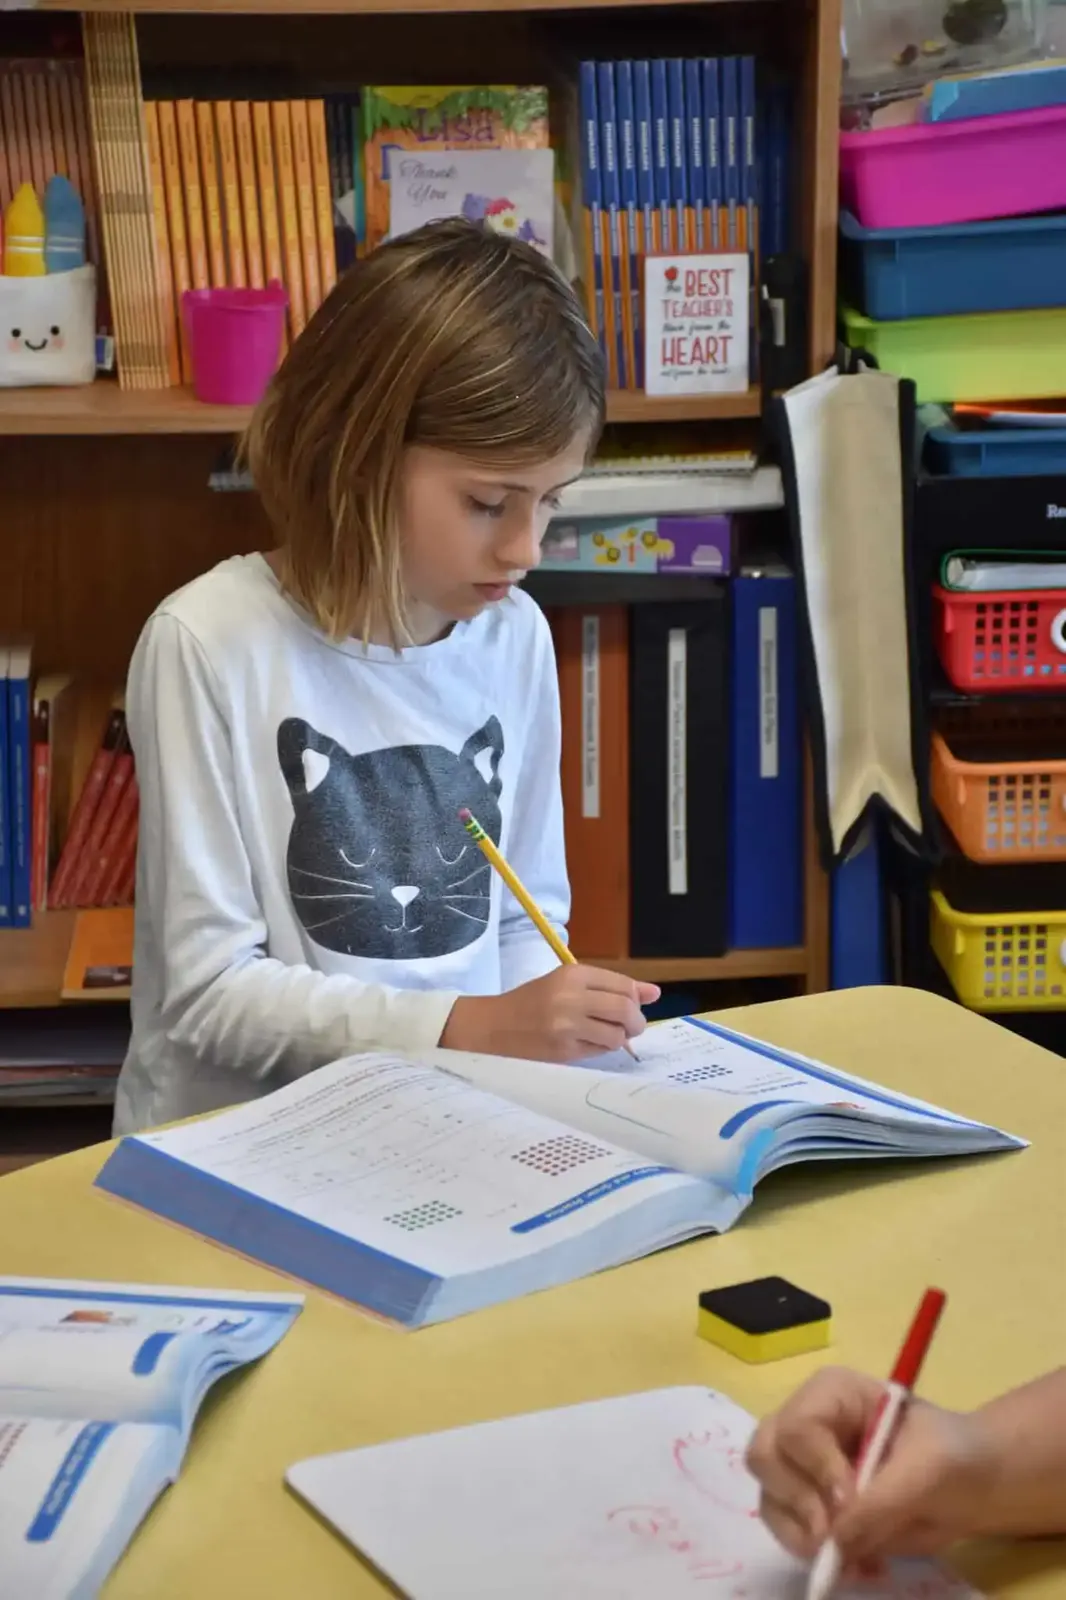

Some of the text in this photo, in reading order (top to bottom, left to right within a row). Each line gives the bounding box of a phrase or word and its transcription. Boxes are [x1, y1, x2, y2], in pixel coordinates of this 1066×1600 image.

[400, 160, 457, 179] Thank
[407, 183, 447, 207] You
[685, 268, 733, 297] BEST
[662, 336, 734, 366] HEART
